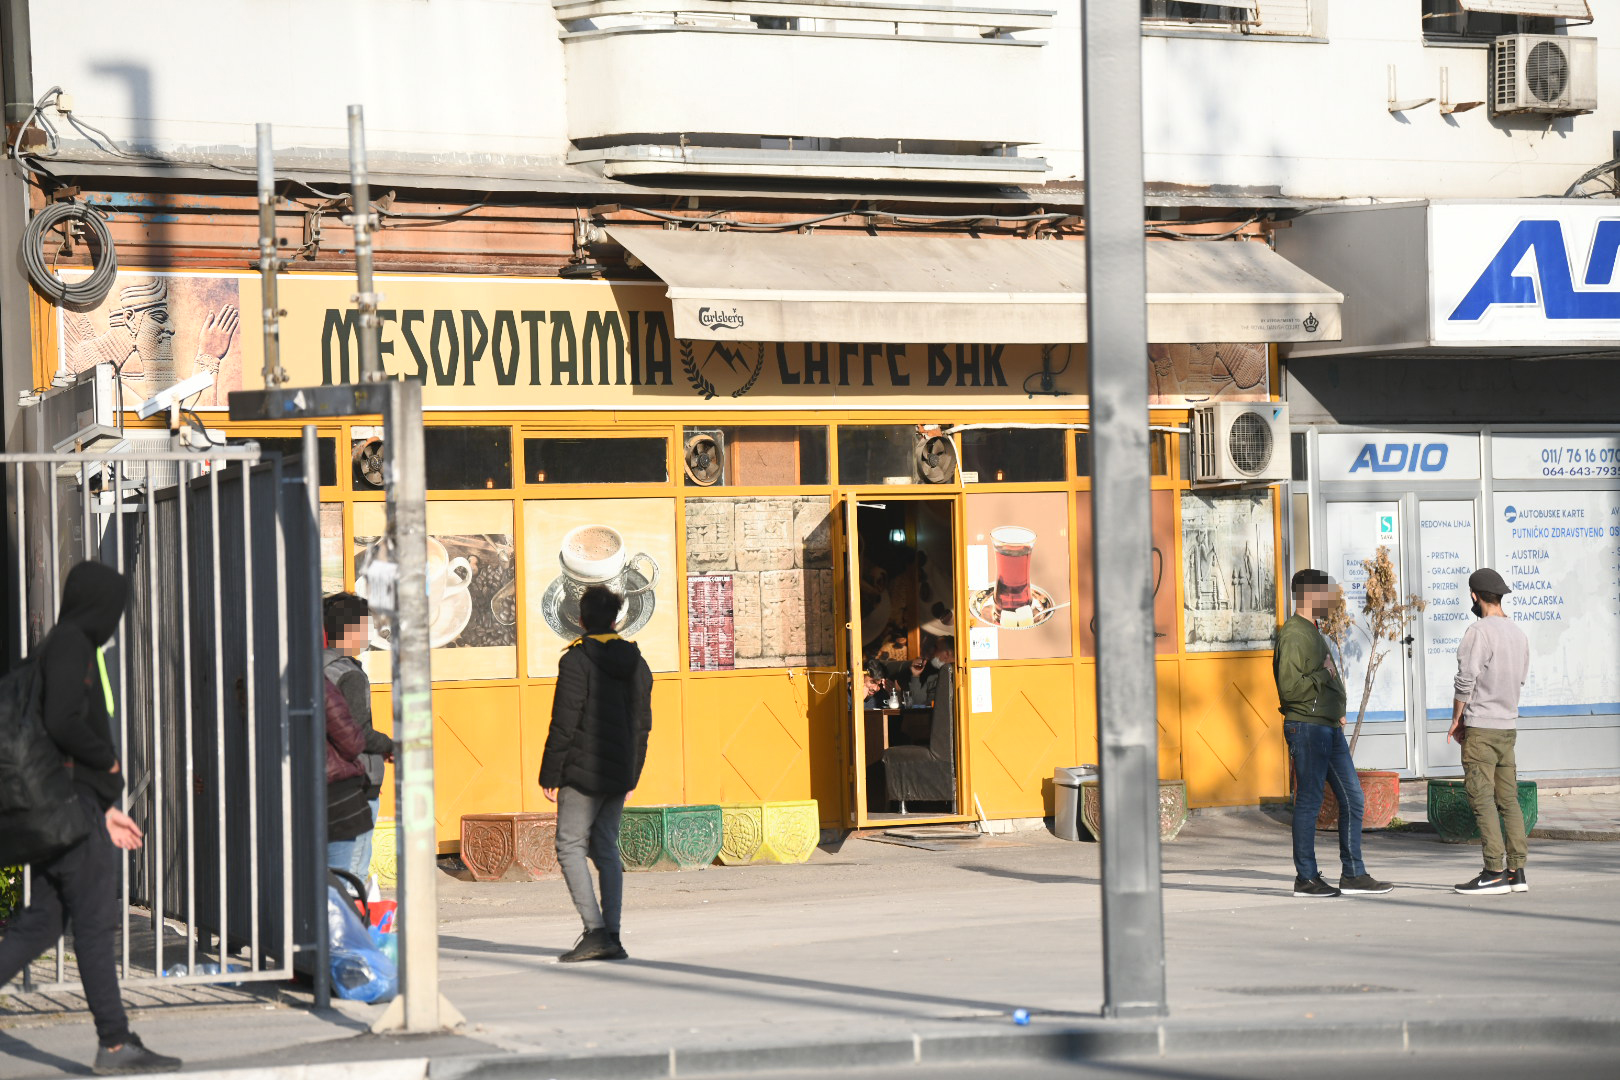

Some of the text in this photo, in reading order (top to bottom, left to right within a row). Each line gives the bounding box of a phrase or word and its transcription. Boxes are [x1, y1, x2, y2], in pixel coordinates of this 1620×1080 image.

[698, 306, 744, 328] Carlsberg
[320, 308, 673, 386] MESOPOTAMIA
[1348, 443, 1449, 473] ADIO
[1541, 446, 1563, 465] 011/
[1566, 448, 1582, 463] 76
[1585, 448, 1596, 463] 16
[1518, 509, 1585, 519] AUTOBUSKE KARTE
[1420, 520, 1452, 529] REDOVNA
[1551, 527, 1604, 538] ZDRAVSTVENO
[1511, 549, 1550, 560] AUSTRIJA
[1511, 565, 1540, 575] ITALIJA
[1432, 582, 1459, 590] PRIZREN
[1433, 612, 1470, 621] BREZOVICA
[1513, 611, 1562, 621] FRANCUSKA
